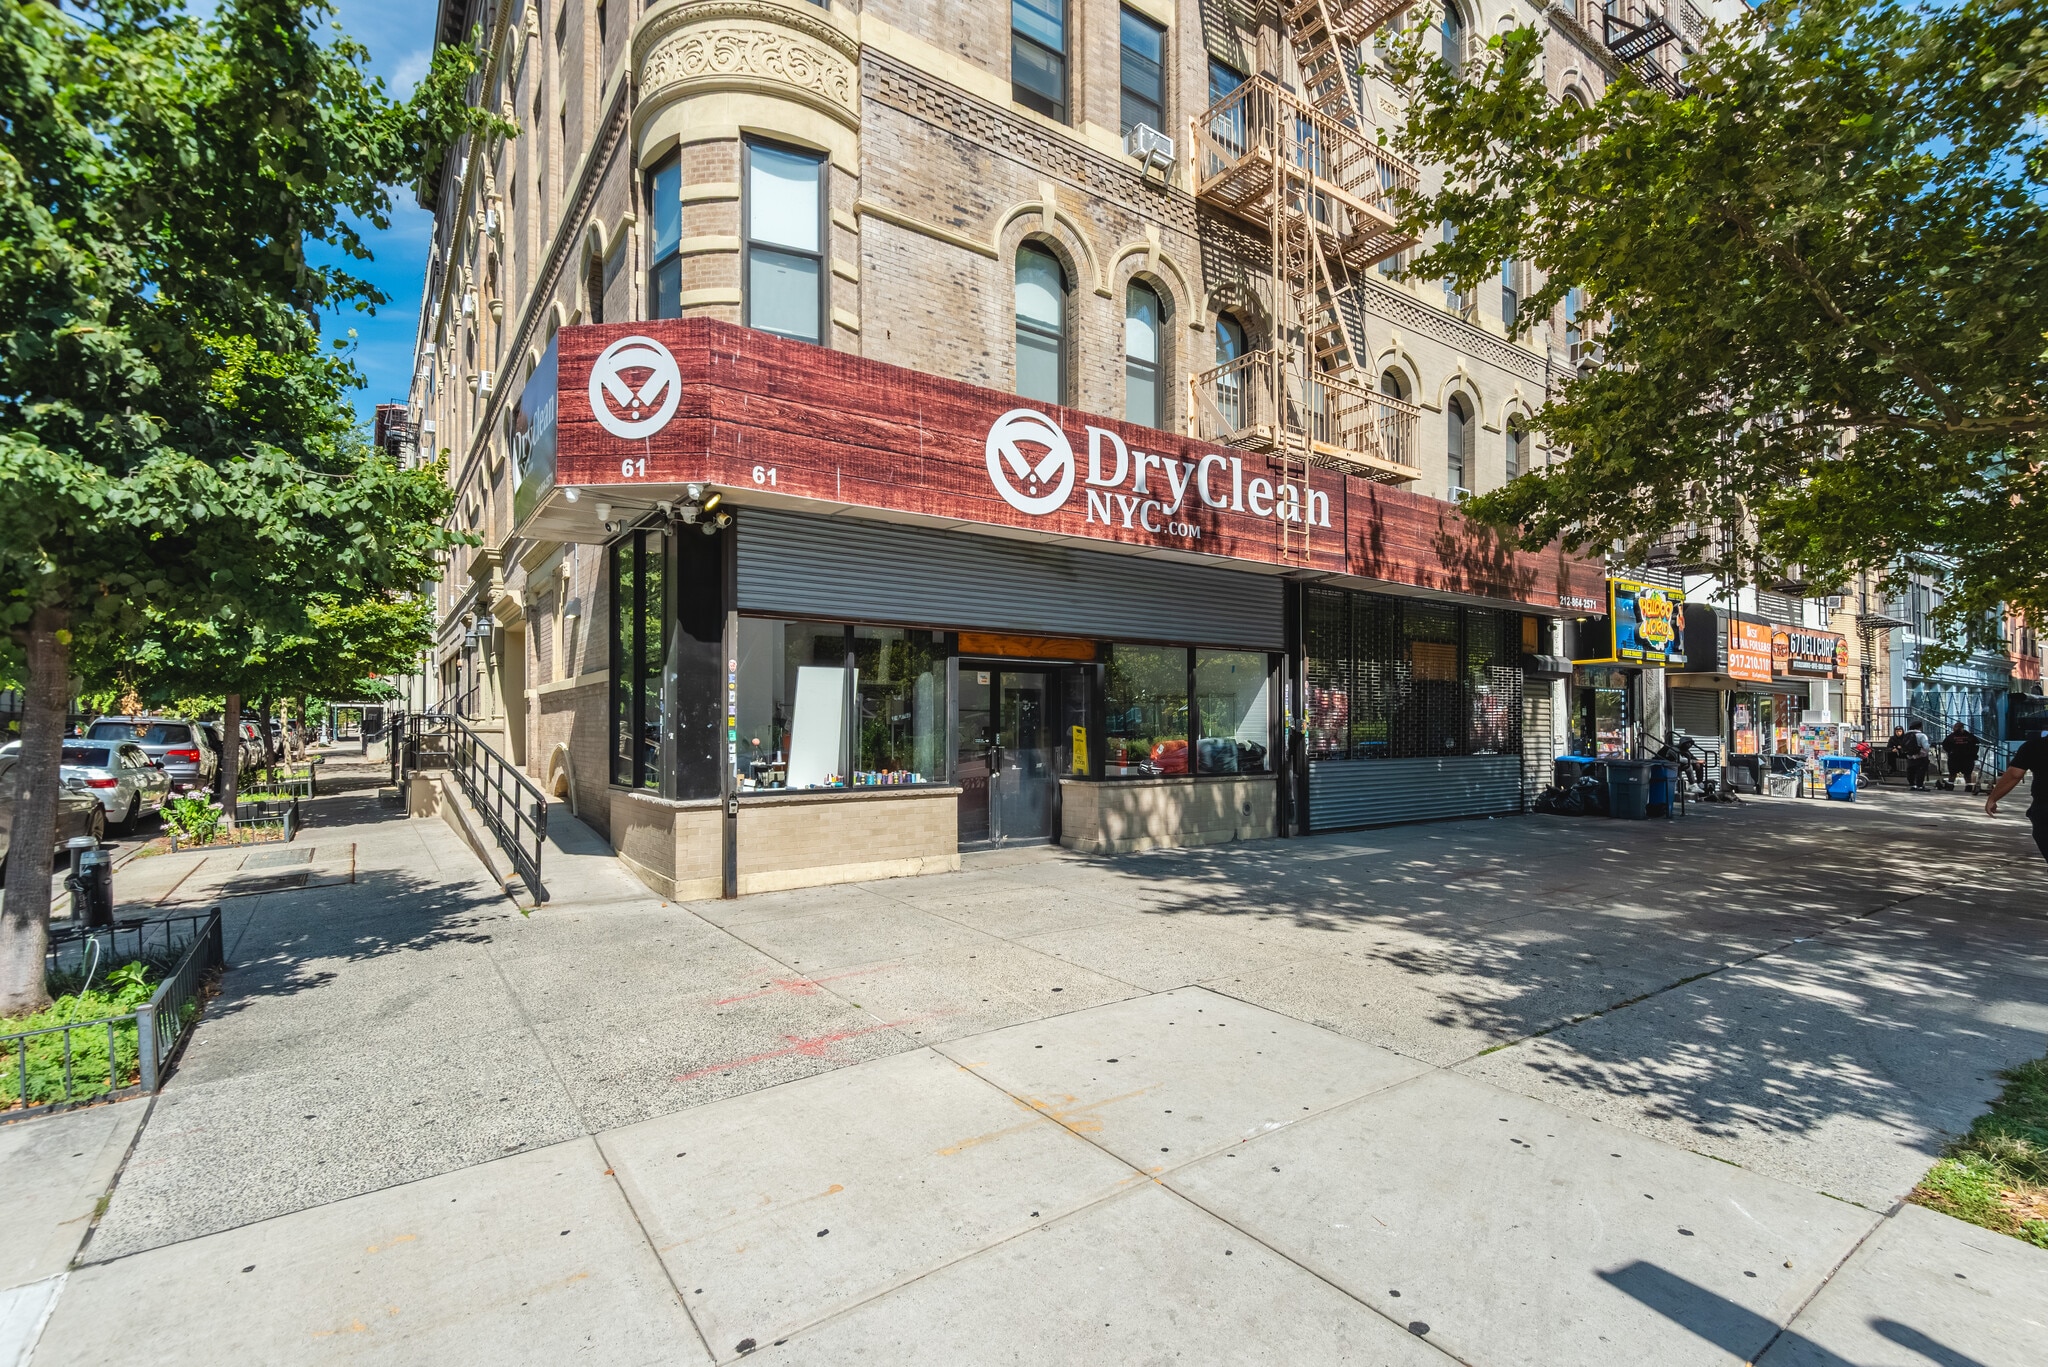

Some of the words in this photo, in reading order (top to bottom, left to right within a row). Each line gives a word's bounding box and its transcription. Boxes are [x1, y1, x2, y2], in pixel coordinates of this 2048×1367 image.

[621, 458, 646, 478] 61
[752, 465, 777, 486] 61
[1085, 424, 1332, 529] DryClean
[1560, 595, 1597, 609] 212-864-2571
[1790, 633, 1800, 653] 67
[1801, 635, 1816, 655] DELI
[1816, 637, 1835, 657] CORP
